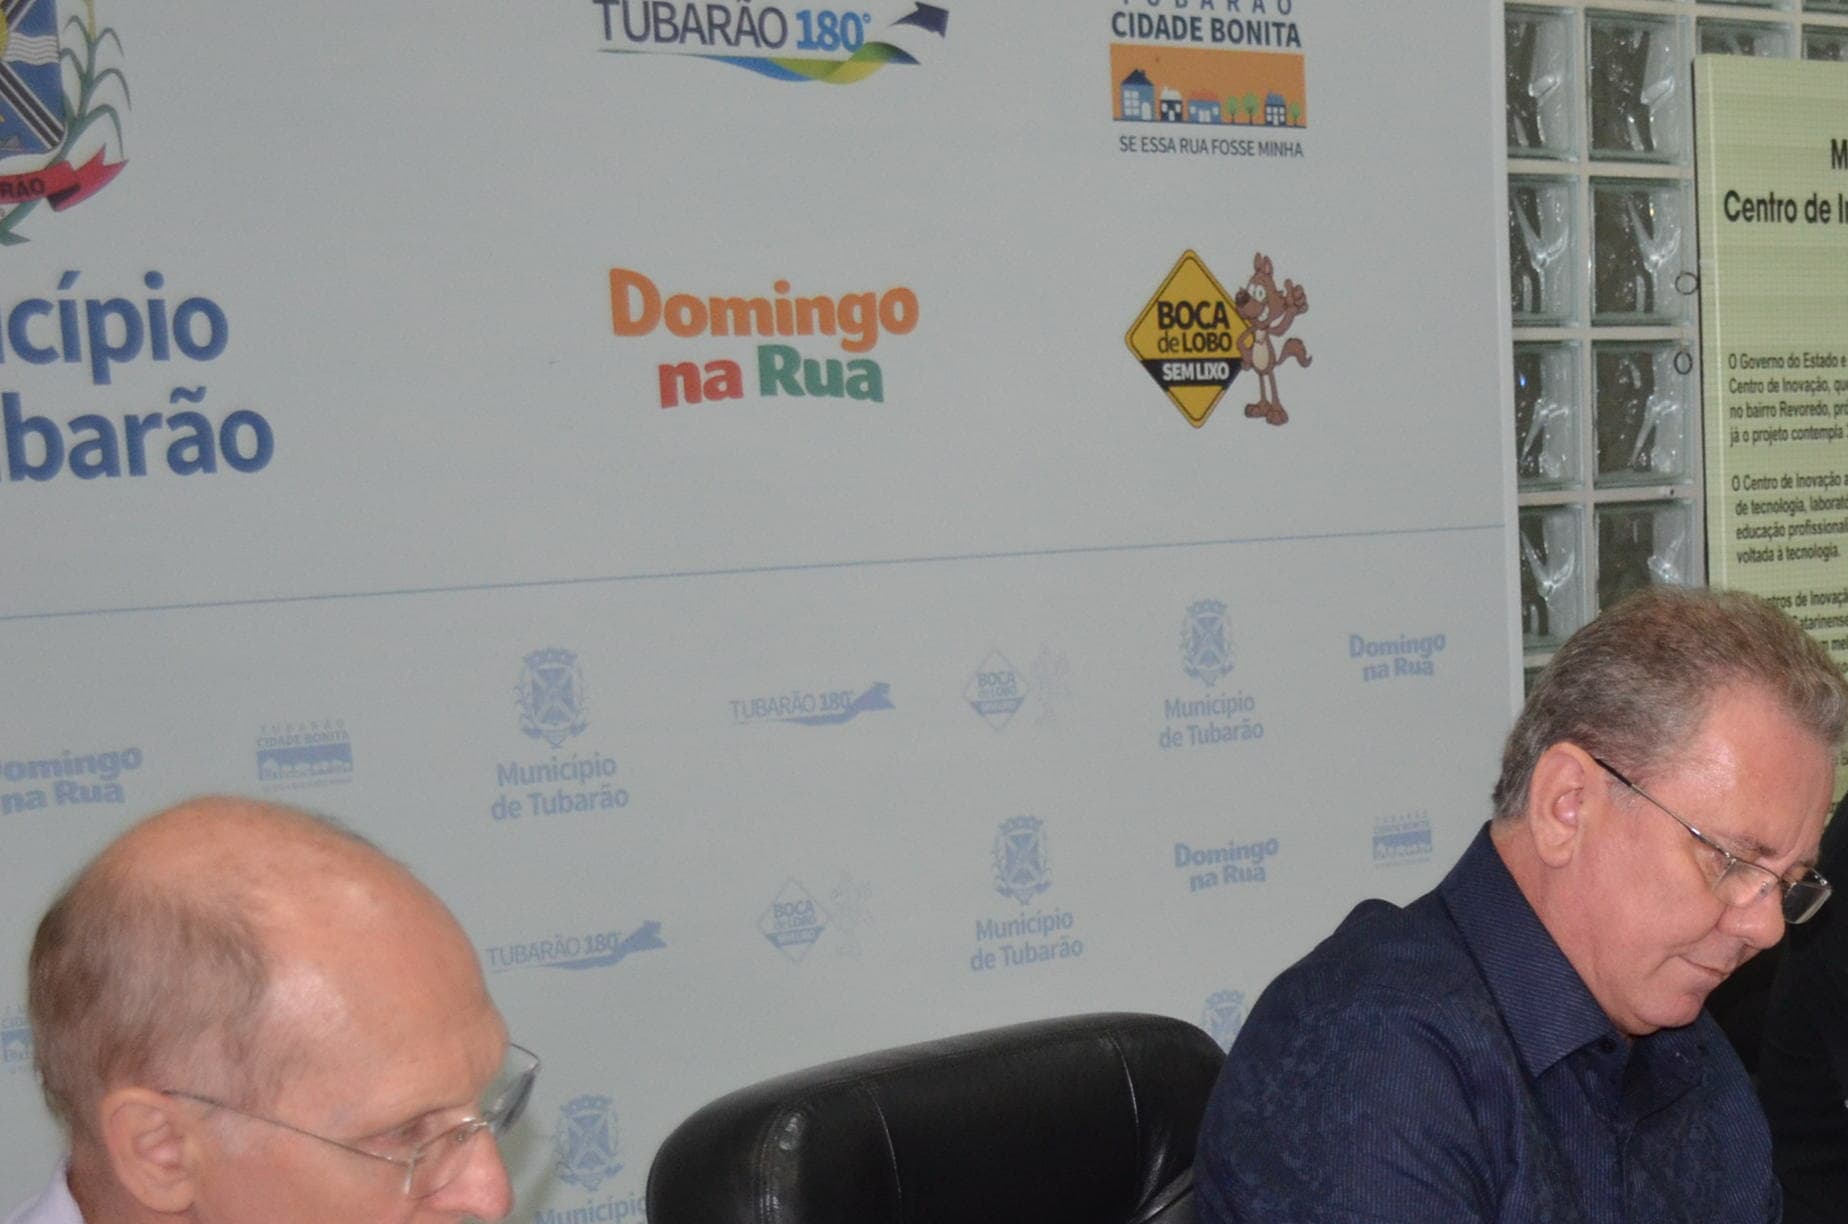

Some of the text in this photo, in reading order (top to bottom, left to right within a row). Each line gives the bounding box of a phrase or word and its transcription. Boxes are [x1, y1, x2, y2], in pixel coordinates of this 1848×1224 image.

[1112, 11, 1301, 47] CIDADE BONITA
[1119, 136, 1304, 157] SE ESSA RUA FOSSE MINHA
[1, 178, 45, 197] RÃO
[1724, 190, 1797, 222] Centro
[1805, 193, 1831, 224] de
[609, 267, 919, 353] Domingo
[1157, 301, 1230, 330] BOCA
[0, 270, 229, 385] cípio
[1158, 331, 1232, 353] de LOBO
[1163, 362, 1229, 381] SEM LIXO
[1728, 353, 1737, 369] O
[1740, 353, 1785, 369] Governo
[1787, 353, 1800, 368] do
[1803, 352, 1838, 368] Estado
[658, 344, 884, 408] na Rua
[1729, 378, 1764, 393] Centro
[1767, 378, 1779, 393] de
[1783, 376, 1831, 396] Inovação,
[1730, 406, 1743, 418] no
[1746, 402, 1777, 418] bairro
[0, 386, 274, 482] barão
[1752, 426, 1789, 446] projeto
[1791, 424, 1843, 445] contempla
[1732, 474, 1741, 491] O
[1743, 474, 1778, 491] Centro
[1781, 473, 1793, 489] de
[1796, 471, 1841, 490] Inovação
[1735, 500, 1748, 516] de
[1736, 521, 1785, 541] educação
[1737, 547, 1774, 563] voltada
[1795, 592, 1807, 607] de
[1349, 633, 1446, 658] Domingo
[1362, 657, 1434, 682] na Rua
[1164, 690, 1255, 719] Município
[1160, 719, 1264, 748] de Tubarão
[0, 747, 143, 781] omingo
[496, 752, 617, 787] Município
[1, 780, 125, 815] na Rua
[491, 784, 629, 821] de Tubarão
[1174, 837, 1280, 868] Domingo
[1190, 864, 1266, 892] na Rua
[976, 907, 1074, 941] Município
[970, 935, 1083, 972] de Tubarão
